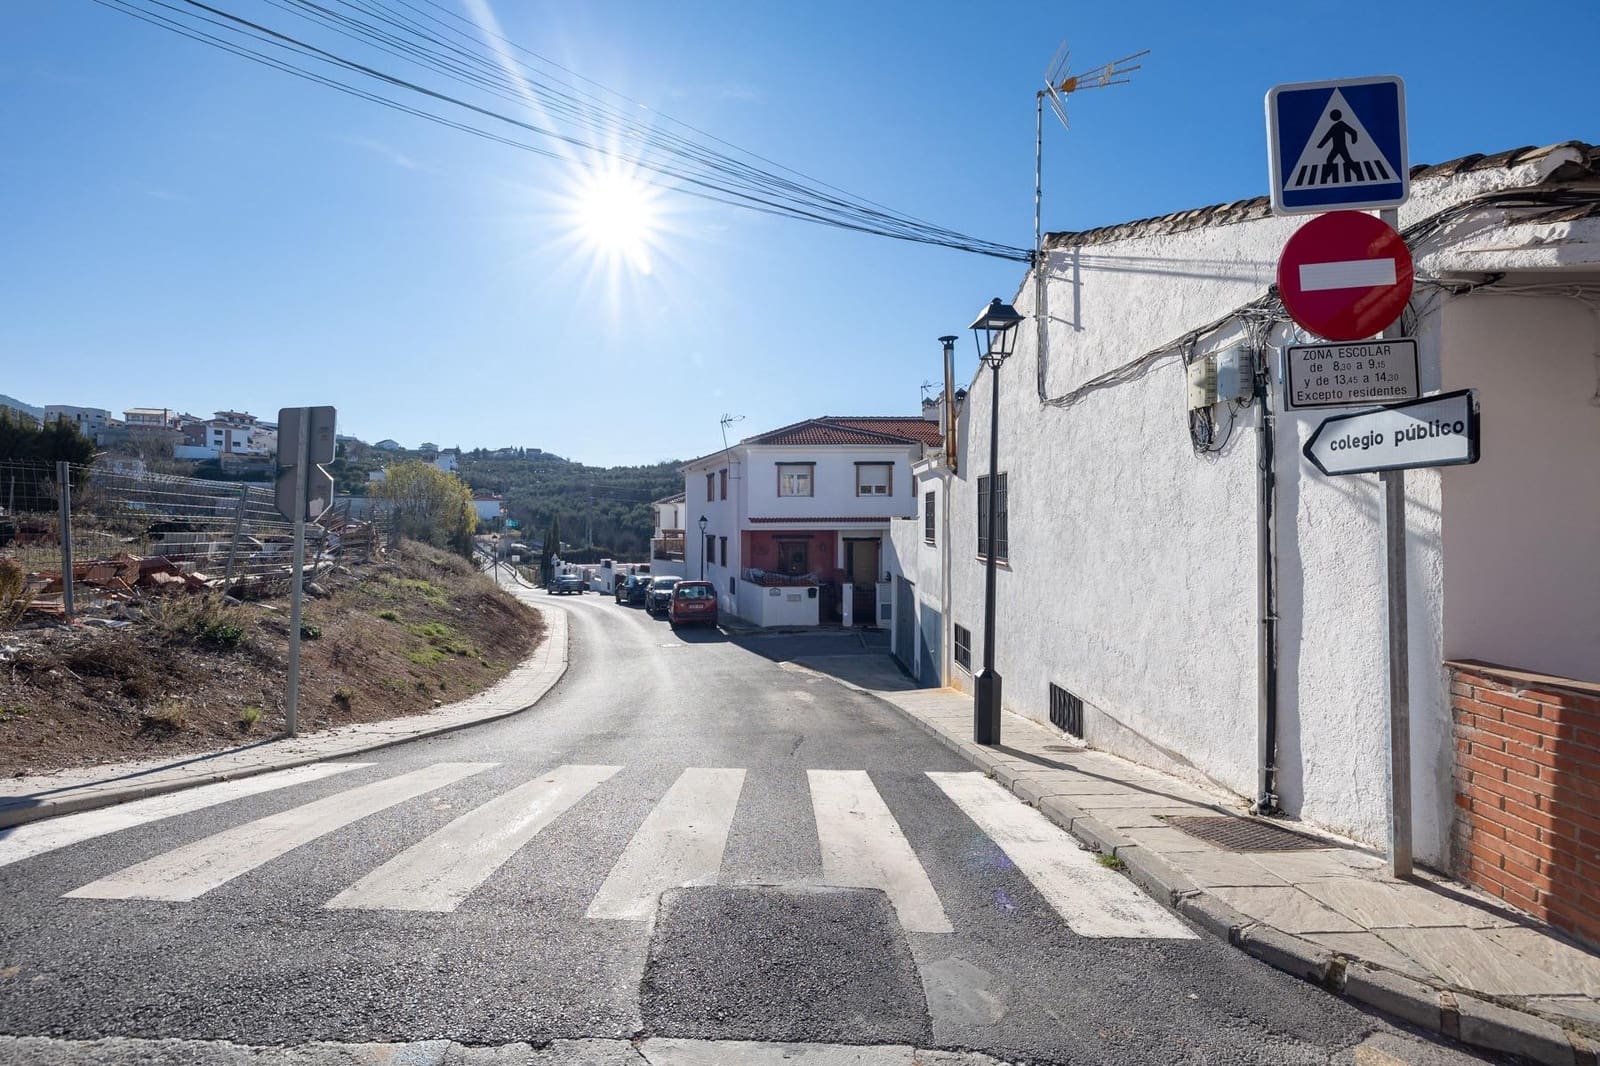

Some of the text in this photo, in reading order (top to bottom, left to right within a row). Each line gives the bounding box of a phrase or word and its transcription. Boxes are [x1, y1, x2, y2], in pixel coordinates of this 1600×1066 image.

[1303, 345, 1391, 360] ZONA ESCOLAR
[1310, 363, 1323, 373] de
[1356, 362, 1363, 370] a
[1303, 378, 1310, 388] y
[1316, 376, 1329, 386] de
[1363, 375, 1369, 383] a
[1297, 386, 1408, 401] Excepto residentes
[1330, 419, 1465, 451] colegio público
